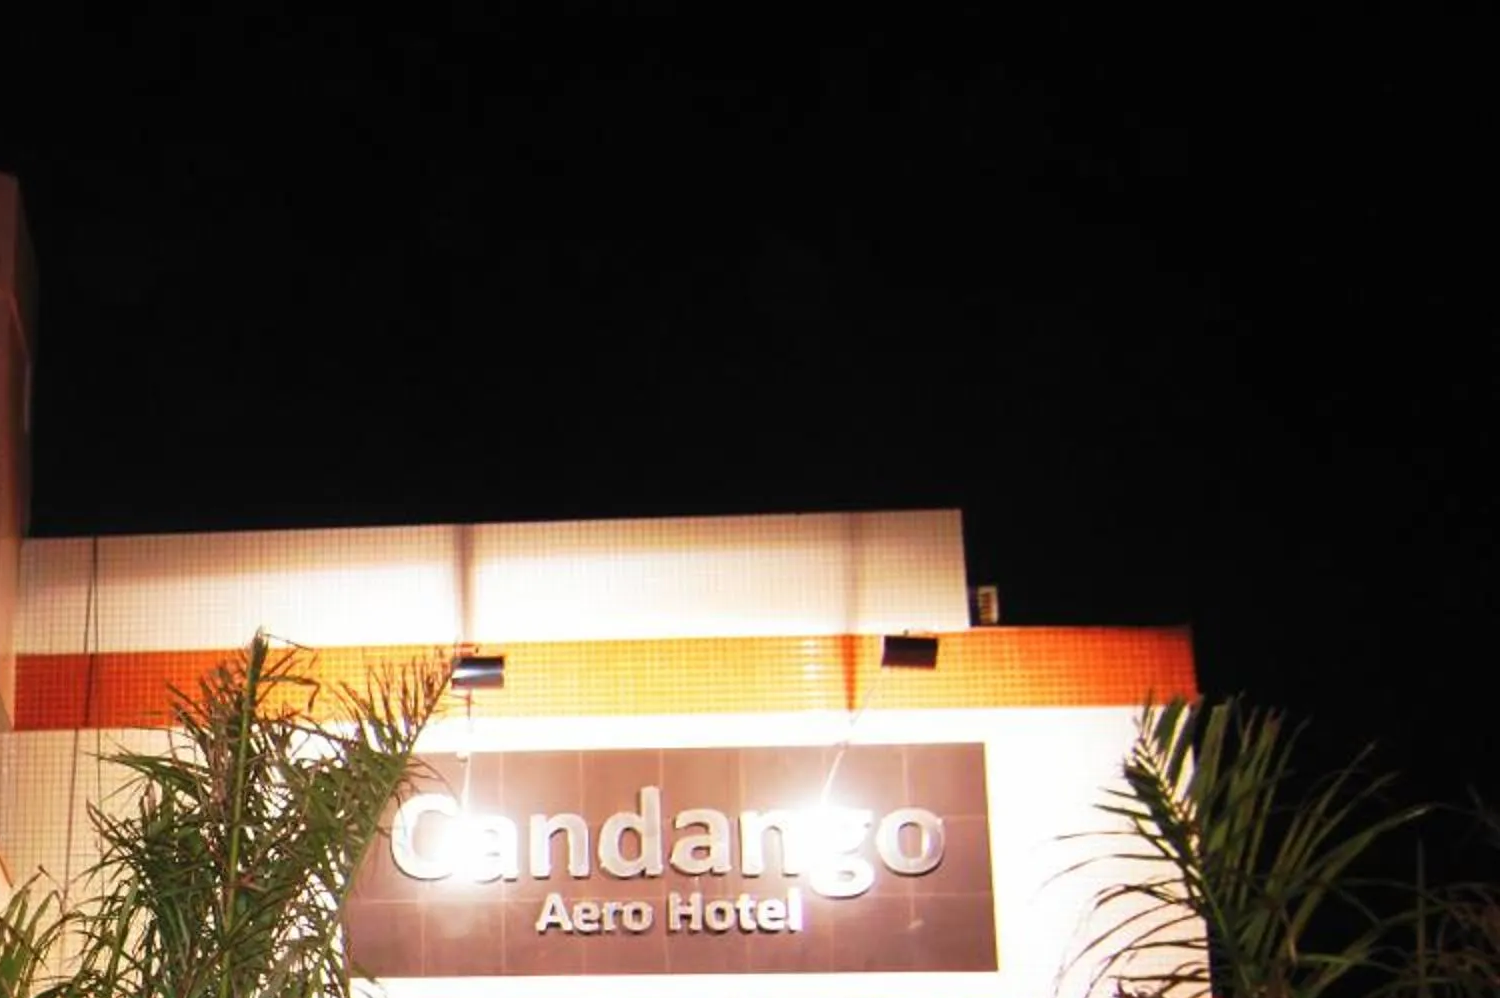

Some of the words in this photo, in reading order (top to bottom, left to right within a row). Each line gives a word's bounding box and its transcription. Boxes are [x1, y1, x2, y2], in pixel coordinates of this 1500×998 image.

[389, 786, 946, 898] Candango
[535, 891, 653, 933] Aero
[668, 888, 804, 933] Hotel
